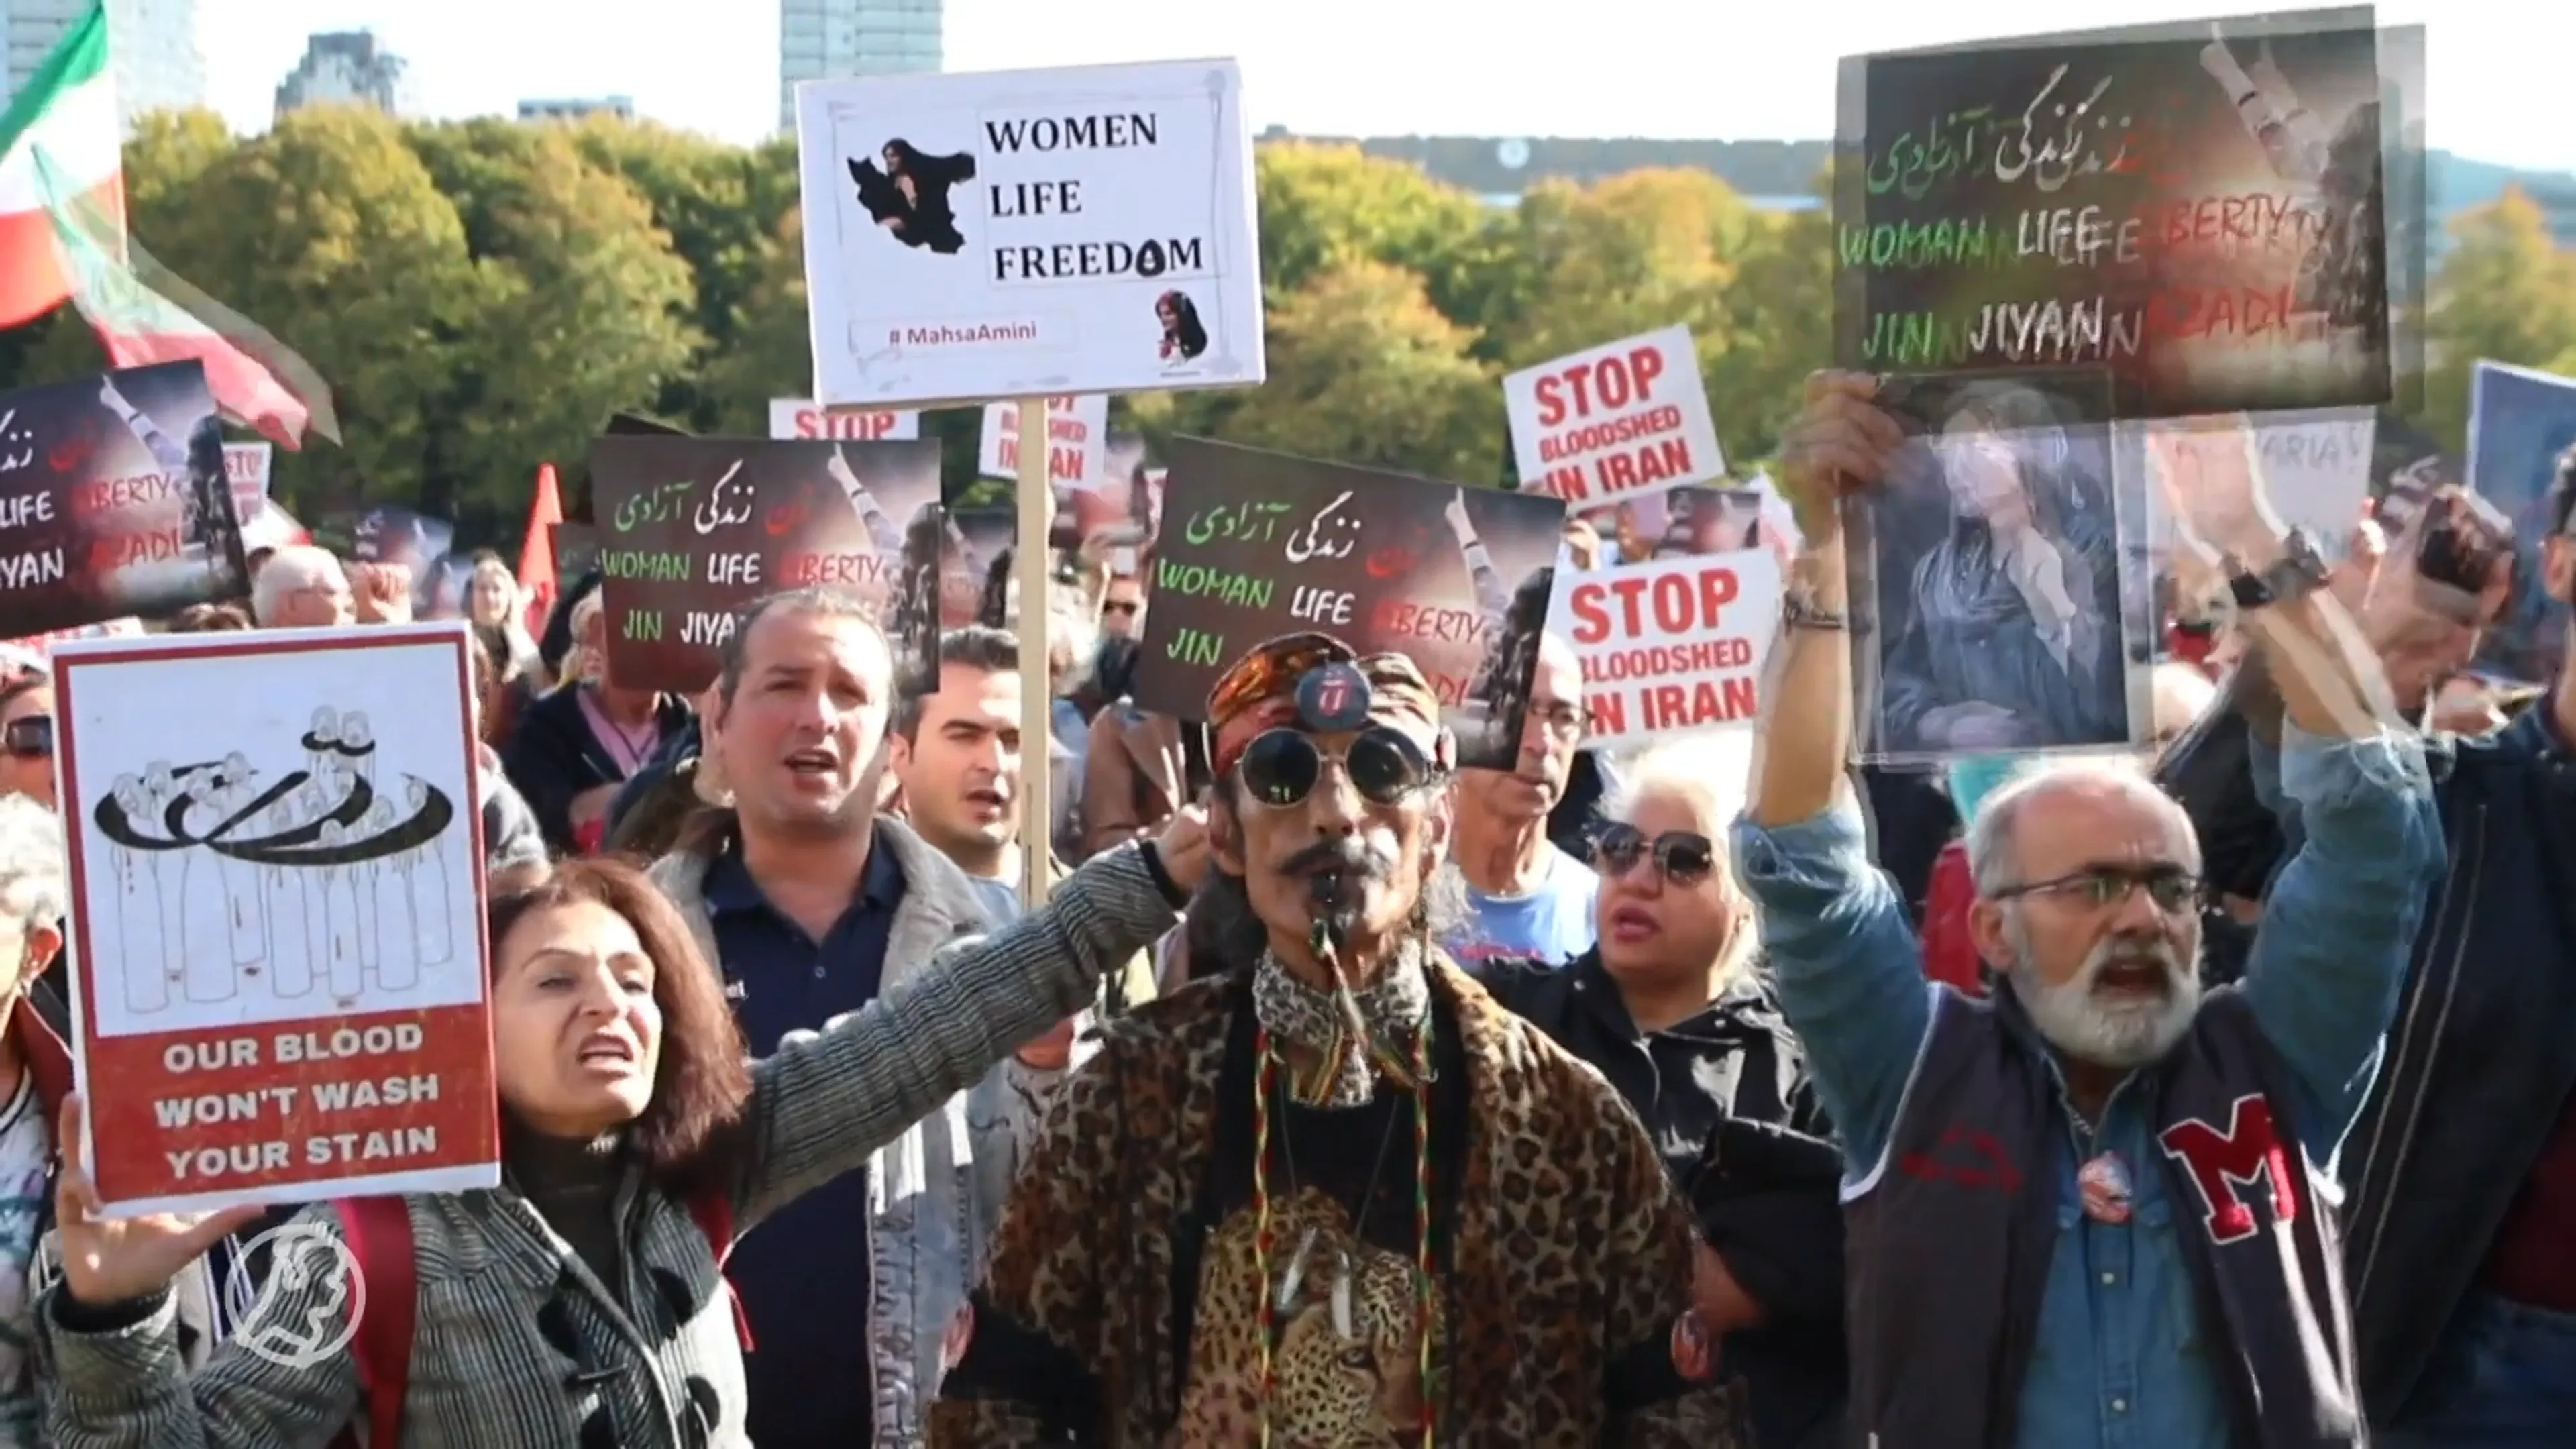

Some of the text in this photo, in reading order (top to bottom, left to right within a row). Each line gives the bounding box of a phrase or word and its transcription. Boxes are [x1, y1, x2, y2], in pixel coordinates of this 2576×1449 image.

[985, 112, 1158, 154] WOMEN
[990, 180, 1081, 218] LIFE
[994, 237, 1203, 280] FREEDOM
[907, 321, 1038, 345] MahsaAmini
[1535, 346, 1663, 427] STOP
[795, 409, 895, 439] STOP
[1539, 405, 1682, 463] BLOODSHED
[1049, 446, 1085, 482] AN
[1595, 437, 1693, 494] IRAN
[0, 547, 64, 590] YAN
[602, 549, 691, 581] WOMAN
[706, 553, 761, 585] LIFE
[1157, 557, 1273, 609] WOMAN
[1289, 585, 1356, 625] LIFE
[1570, 567, 1739, 645] STOP
[623, 609, 746, 649] JIN JIYA
[1166, 627, 1224, 667] JIN
[1585, 676, 1758, 735] N IRAN
[164, 1023, 423, 1073] OUR BLOOD
[154, 1073, 440, 1130] WON'T WASH
[166, 1126, 437, 1179] YOUR STAIN
[2158, 1091, 2297, 1245] M
